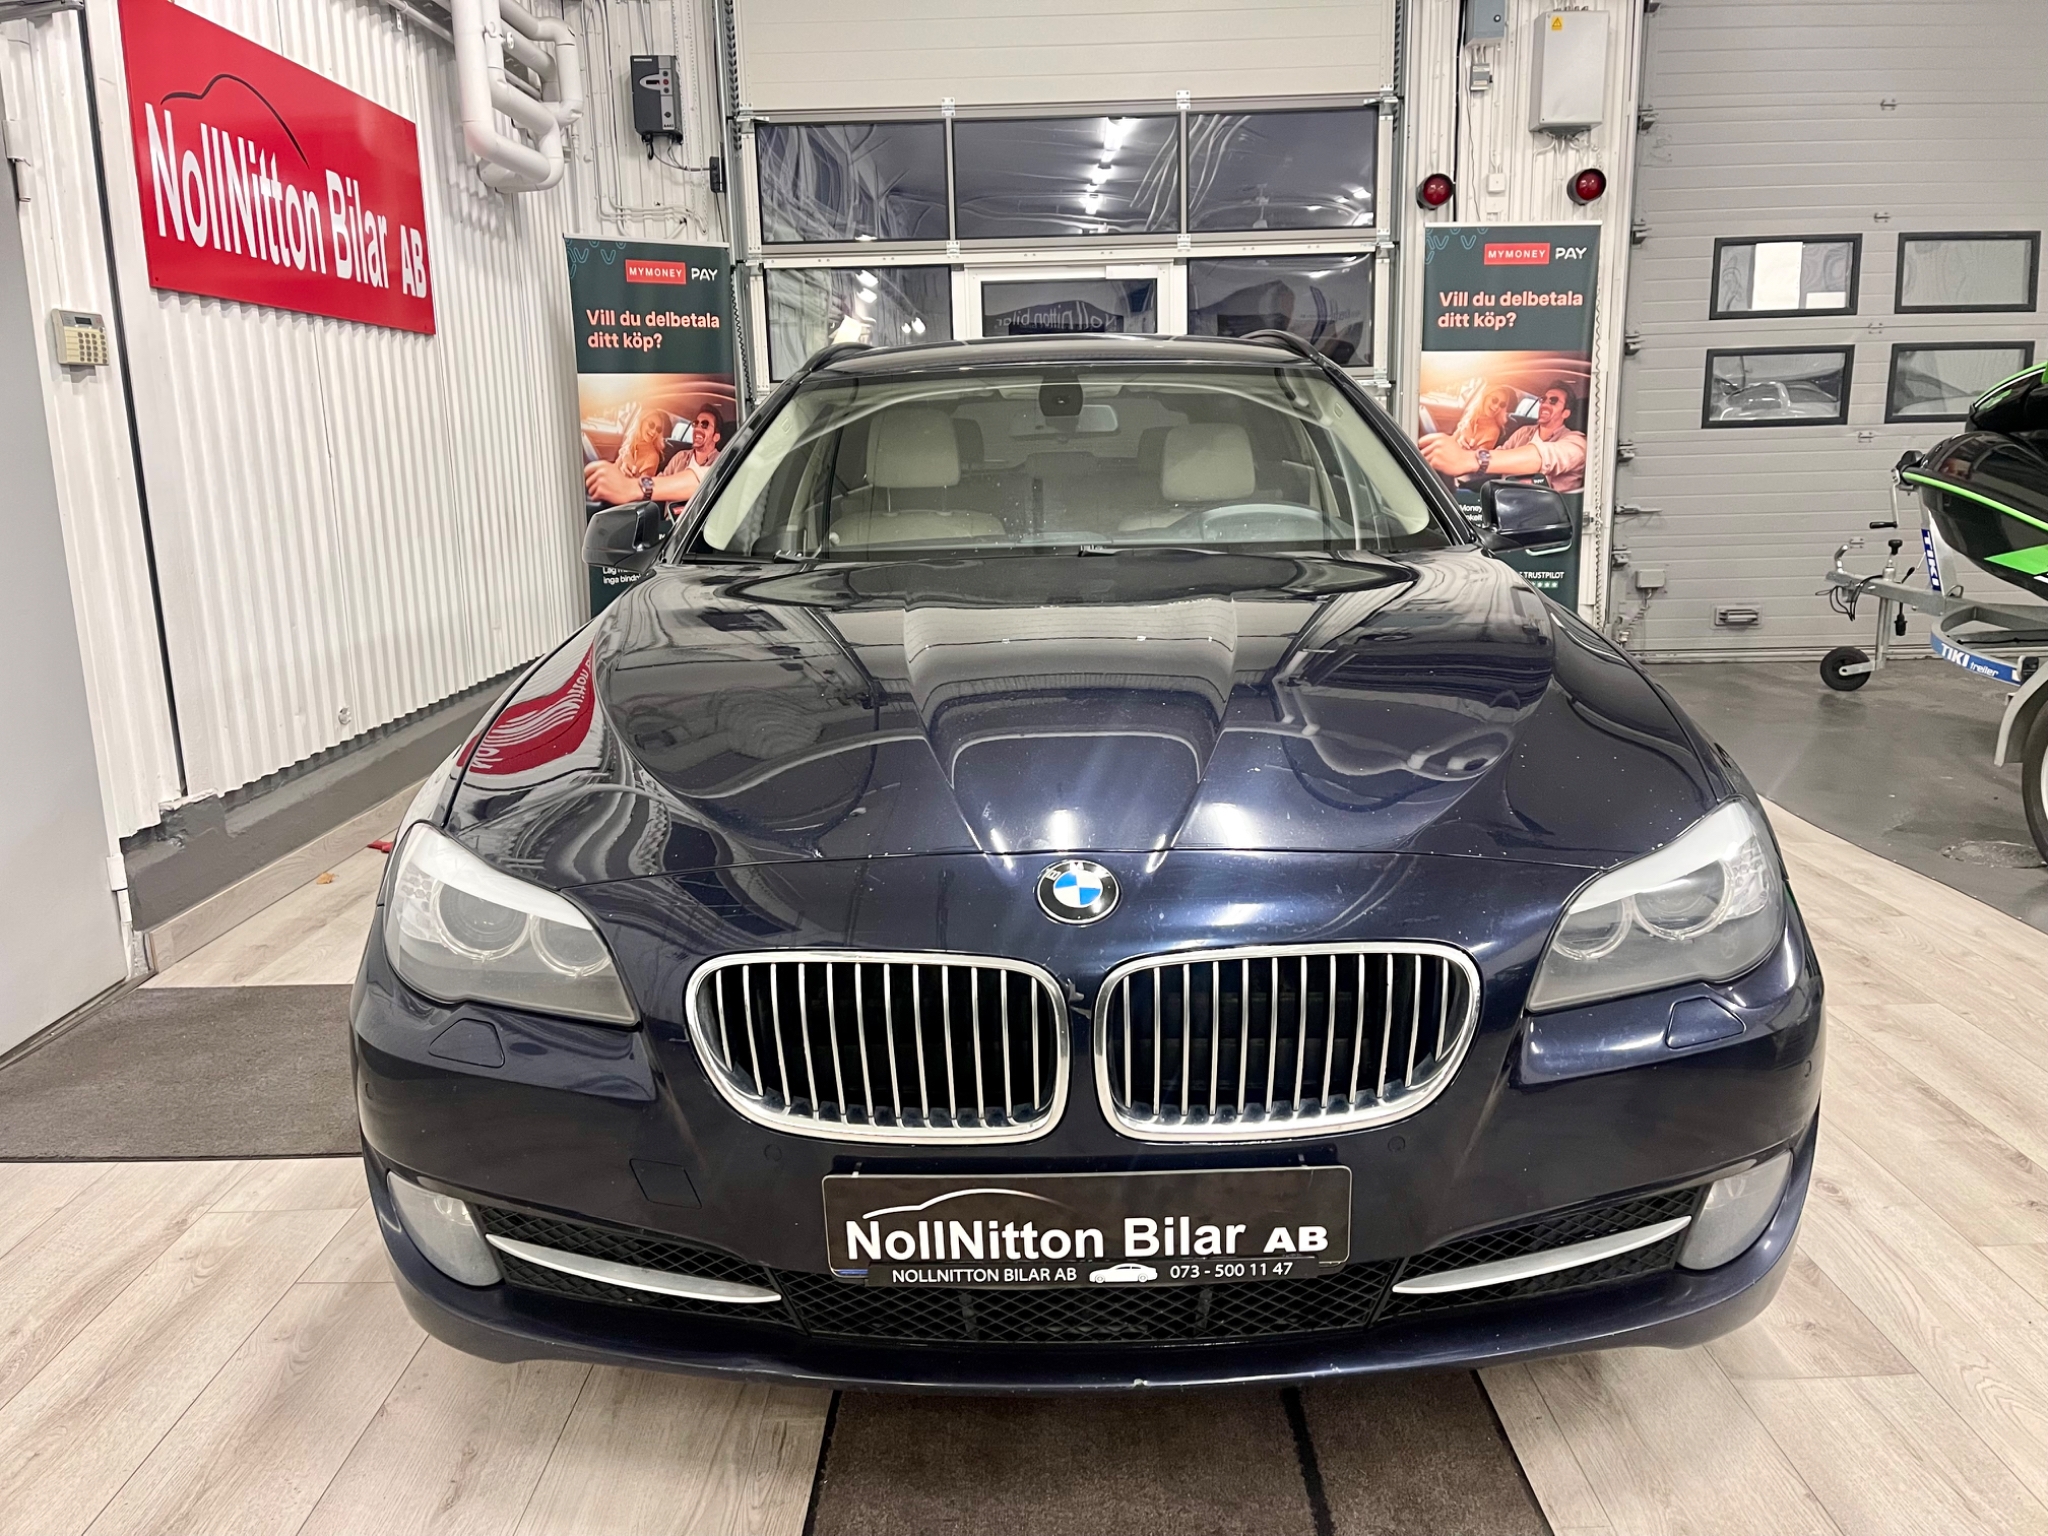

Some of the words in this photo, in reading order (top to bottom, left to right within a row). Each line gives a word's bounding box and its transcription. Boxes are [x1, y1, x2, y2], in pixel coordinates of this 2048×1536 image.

[145, 102, 326, 274] NollNitton
[325, 169, 389, 289] Bilar
[400, 224, 427, 298] AB
[1488, 249, 1546, 258] MYMONEY
[1555, 247, 1587, 260] PAY
[629, 267, 682, 277] MYMONEY
[691, 267, 718, 281] PAY
[1439, 291, 1468, 307] Vill
[1472, 291, 1495, 307] du
[1499, 290, 1583, 306] delbetala
[586, 309, 616, 326] Vill
[620, 311, 641, 327] du
[645, 311, 720, 328] delbetala
[1437, 312, 1470, 328] ditt
[1474, 312, 1517, 330] köp?
[587, 332, 619, 348] ditt
[623, 333, 663, 352] köp?
[1924, 532, 1940, 587] TIKI
[603, 576, 619, 585] inga
[1523, 571, 1565, 579] TRUSTPILOT
[1941, 643, 1970, 667] TIKI
[845, 1220, 1104, 1260] NollNitton
[1124, 1217, 1246, 1257] Bilar
[1263, 1226, 1329, 1252] AB
[892, 1268, 1000, 1283] NOLLNITTON
[1003, 1268, 1050, 1282] BILAR
[1053, 1267, 1077, 1281] AB
[1170, 1264, 1199, 1279] 073
[1215, 1263, 1246, 1278] 500
[1249, 1263, 1267, 1277] 11
[1272, 1262, 1293, 1277] 47
